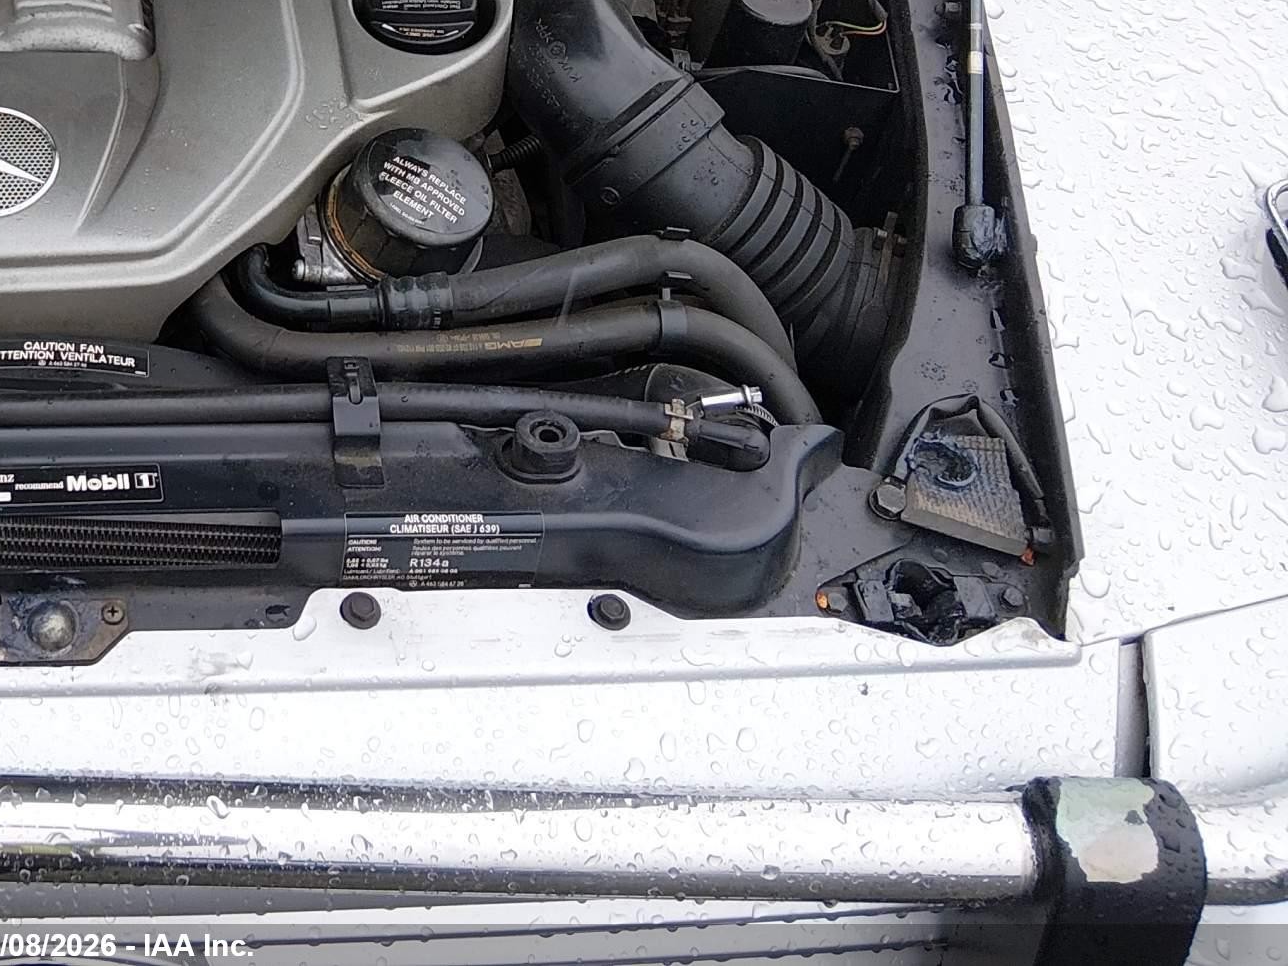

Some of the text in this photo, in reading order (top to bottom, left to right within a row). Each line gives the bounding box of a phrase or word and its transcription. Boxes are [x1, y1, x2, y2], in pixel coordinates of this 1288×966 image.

[384, 162, 465, 216] WITH MB APPROVED
[393, 156, 466, 205] ALWAYS REPLACE
[379, 171, 414, 194] FLEECE
[414, 190, 428, 203] OIL
[429, 199, 458, 224] FILTER
[393, 190, 435, 218] ELEMENT
[23, 341, 104, 354] CAUTION FAN
[484, 340, 525, 350] AMG
[60, 352, 136, 368] VENTILATEUR
[14, 480, 64, 491] recommend
[66, 474, 130, 492] Mobil
[404, 514, 484, 524] AIR CONDITIONER
[390, 524, 500, 534] CLIMATISEUR (SAE J 639)
